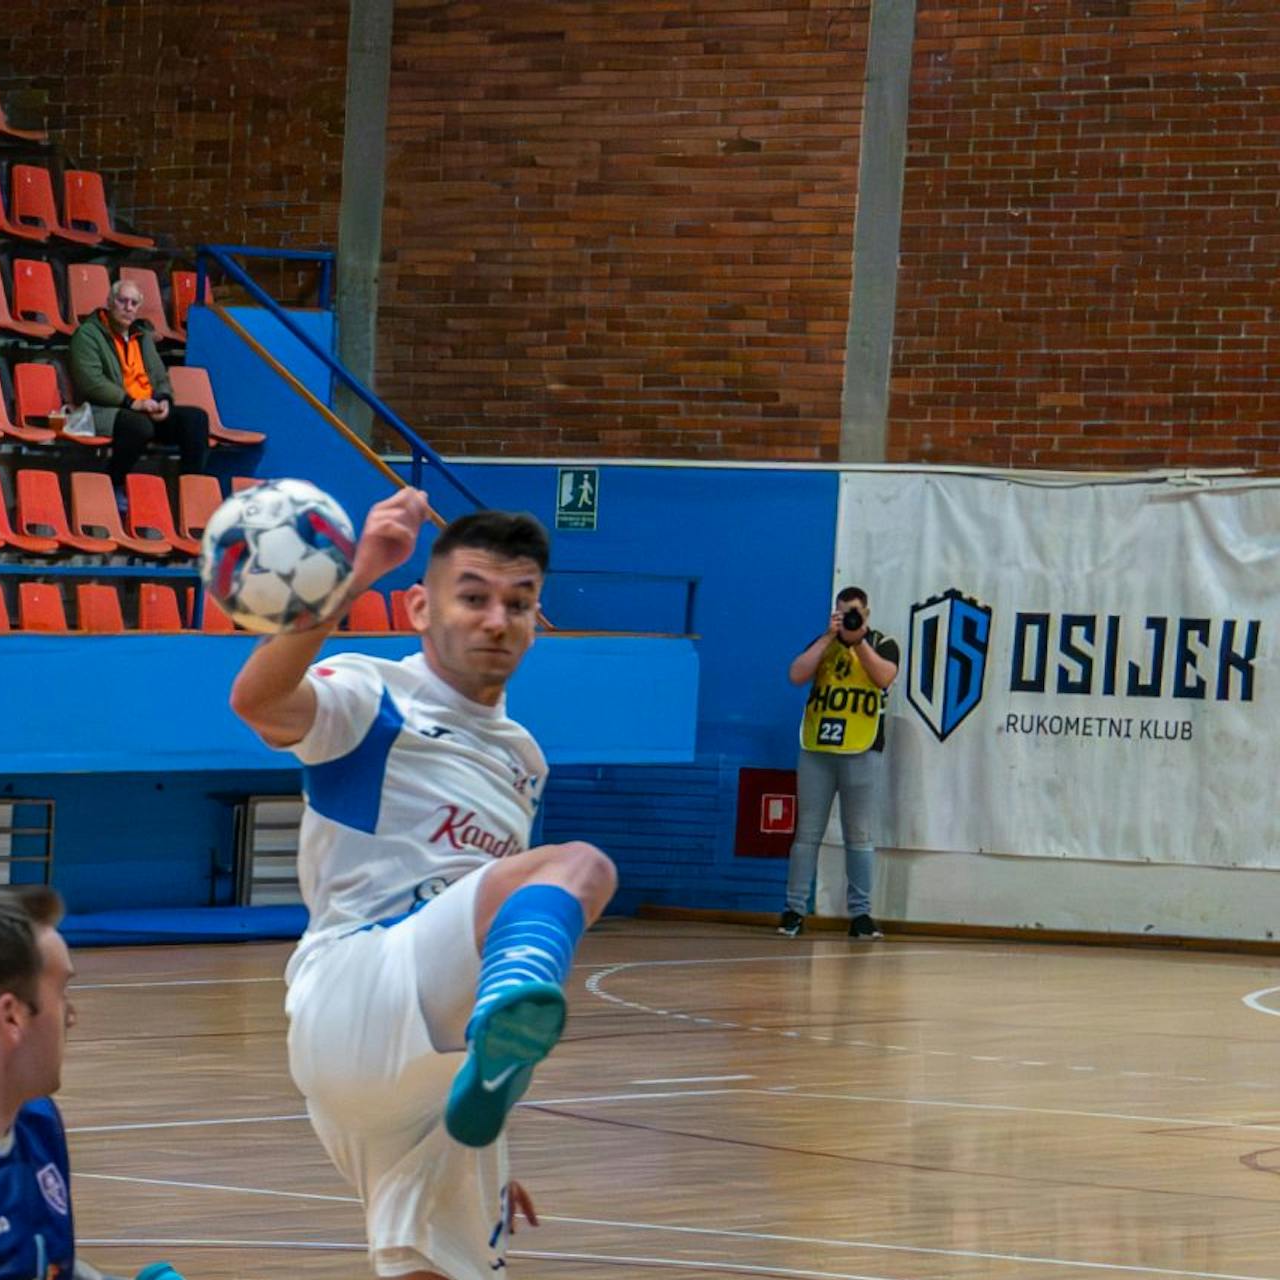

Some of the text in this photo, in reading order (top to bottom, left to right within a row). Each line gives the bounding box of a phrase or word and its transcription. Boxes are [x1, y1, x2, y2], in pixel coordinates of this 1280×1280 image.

[1009, 612, 1262, 702] OSIJEK
[820, 722, 843, 741] 22
[1005, 713, 1194, 741] RUKOMETNI KLUB
